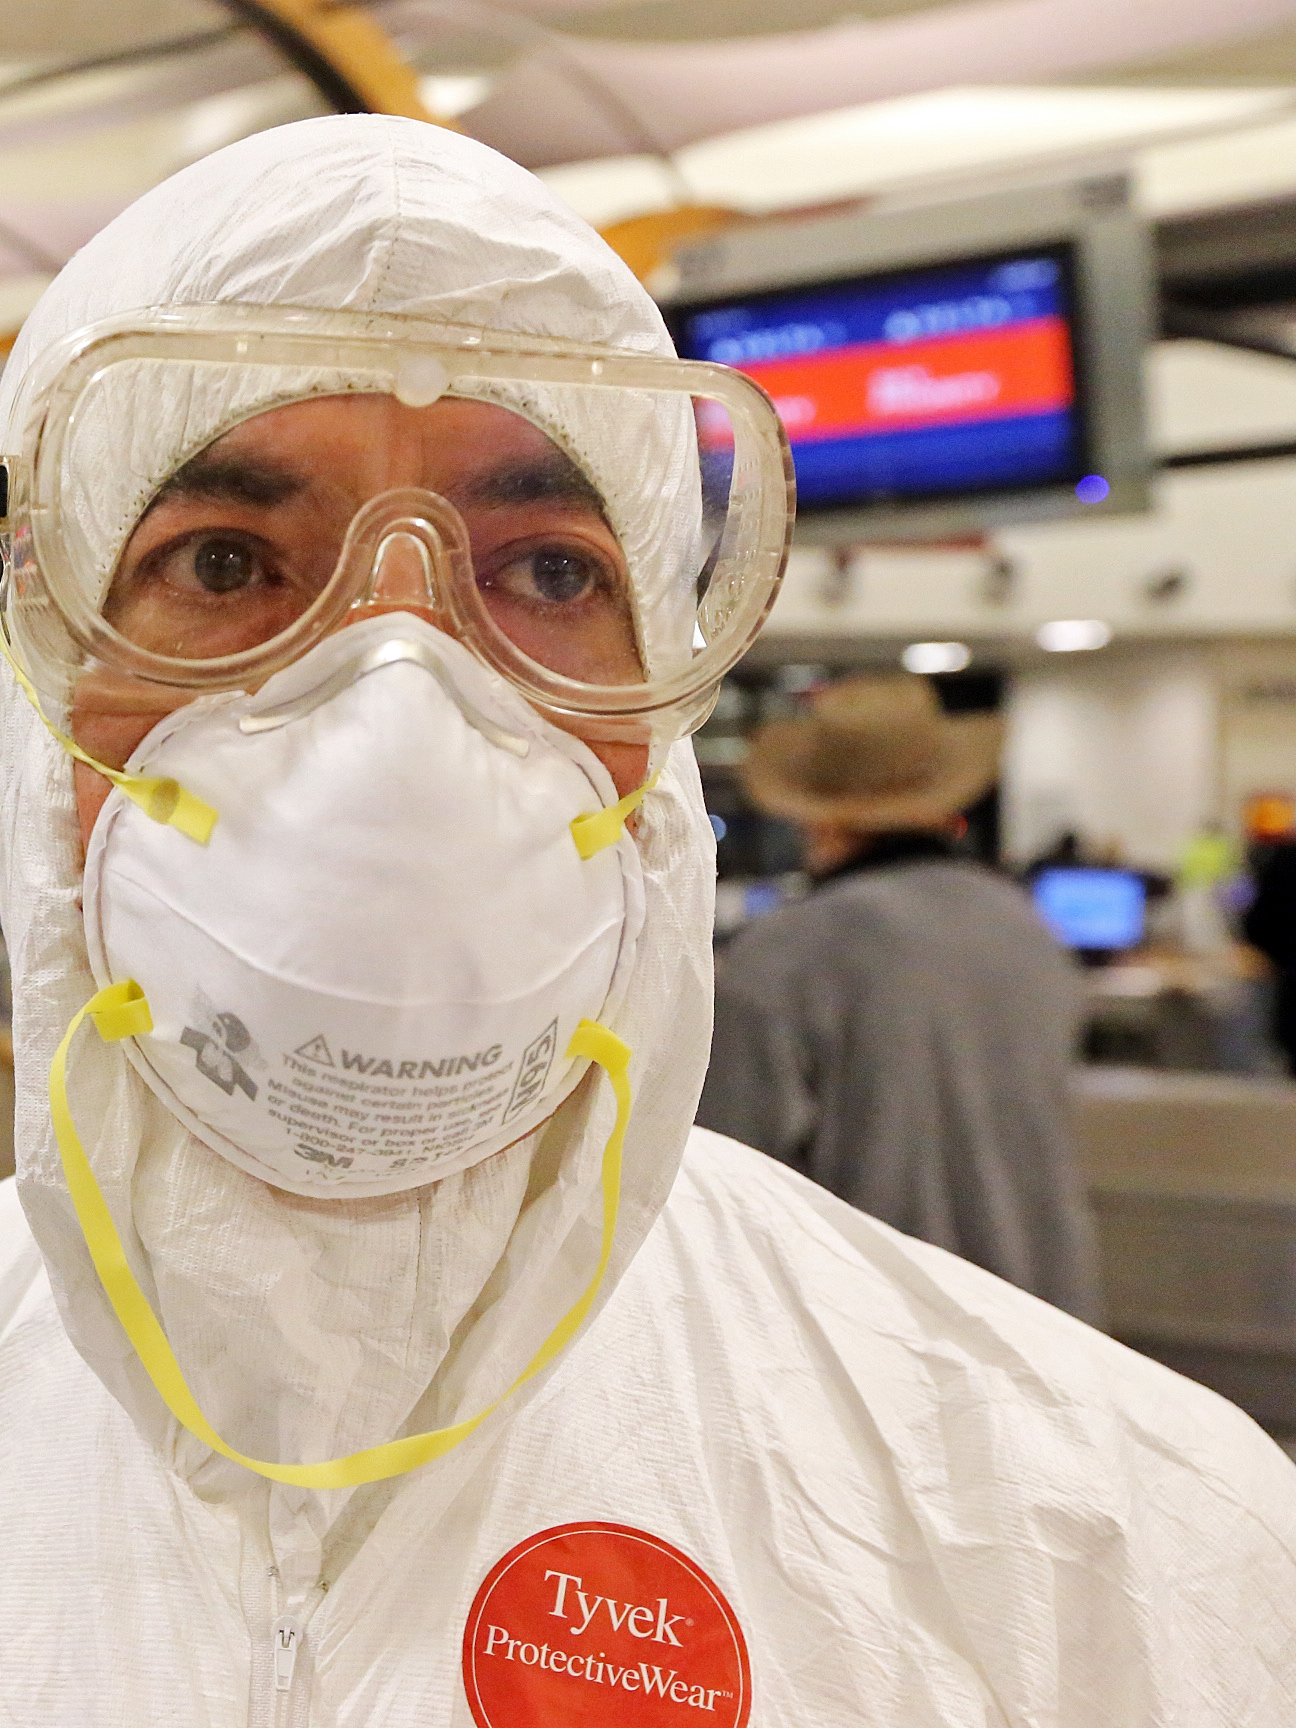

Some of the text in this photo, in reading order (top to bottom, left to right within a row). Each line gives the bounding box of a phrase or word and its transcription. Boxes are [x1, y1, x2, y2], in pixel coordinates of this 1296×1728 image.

[283, 1053, 316, 1076] This
[321, 1073, 406, 1097] respirator
[412, 1082, 458, 1098] helps
[341, 1043, 503, 1078] WARNING
[268, 1078, 328, 1107] Misuse
[333, 1105, 369, 1123] may
[375, 1113, 424, 1125] result
[292, 1077, 356, 1103] against
[361, 1097, 422, 1110] certain
[348, 1121, 377, 1134] For
[294, 1143, 354, 1169] 3M
[544, 1569, 685, 1648] Tyvek
